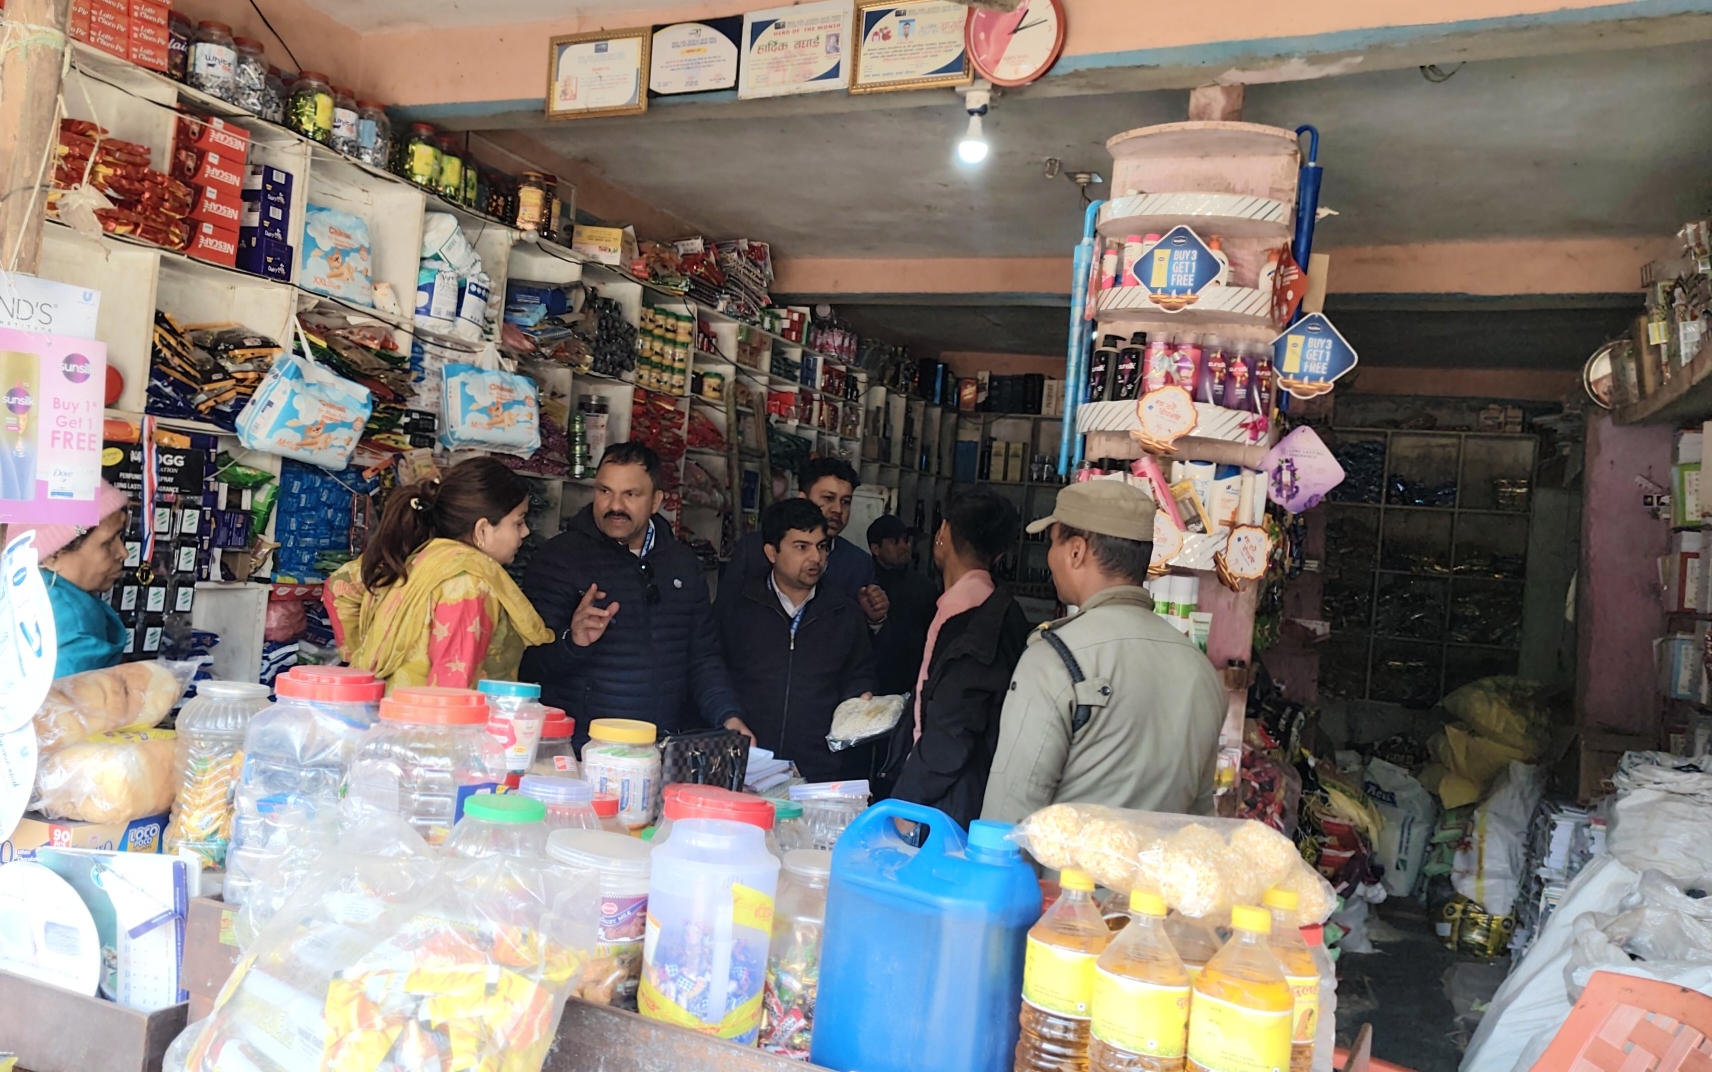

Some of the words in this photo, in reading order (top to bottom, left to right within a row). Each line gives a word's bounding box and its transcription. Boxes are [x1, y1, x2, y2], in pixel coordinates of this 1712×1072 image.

[98, 16, 116, 28] Choco
[140, 11, 157, 22] Choco
[96, 37, 115, 49] Choco
[139, 32, 157, 42] Choco
[138, 53, 157, 64] Choco
[205, 54, 232, 67] White
[204, 165, 241, 187] NESCAFÉ
[202, 200, 238, 220] NESCAFÉ
[198, 234, 234, 255] NESCAFÉ
[1174, 250, 1191, 260] BUY
[1191, 250, 1198, 260] 3
[1172, 262, 1190, 273] GET
[1192, 262, 1196, 273] 1
[1171, 274, 1194, 286] FREE
[1308, 337, 1326, 349] BUY
[1326, 339, 1332, 350] 3
[1306, 349, 1324, 362] GET
[1326, 350, 1330, 362] 1
[1304, 362, 1328, 374] FREE
[2, 395, 35, 406] sunsilk
[52, 397, 79, 413] Buy
[56, 414, 83, 428] Get
[88, 418, 92, 430] 1
[50, 430, 97, 452] FREE
[53, 468, 74, 478] Dove
[53, 828, 70, 842] 90
[128, 824, 160, 842] LOCO
[133, 837, 153, 848] POCO
[617, 911, 631, 922] MILK
